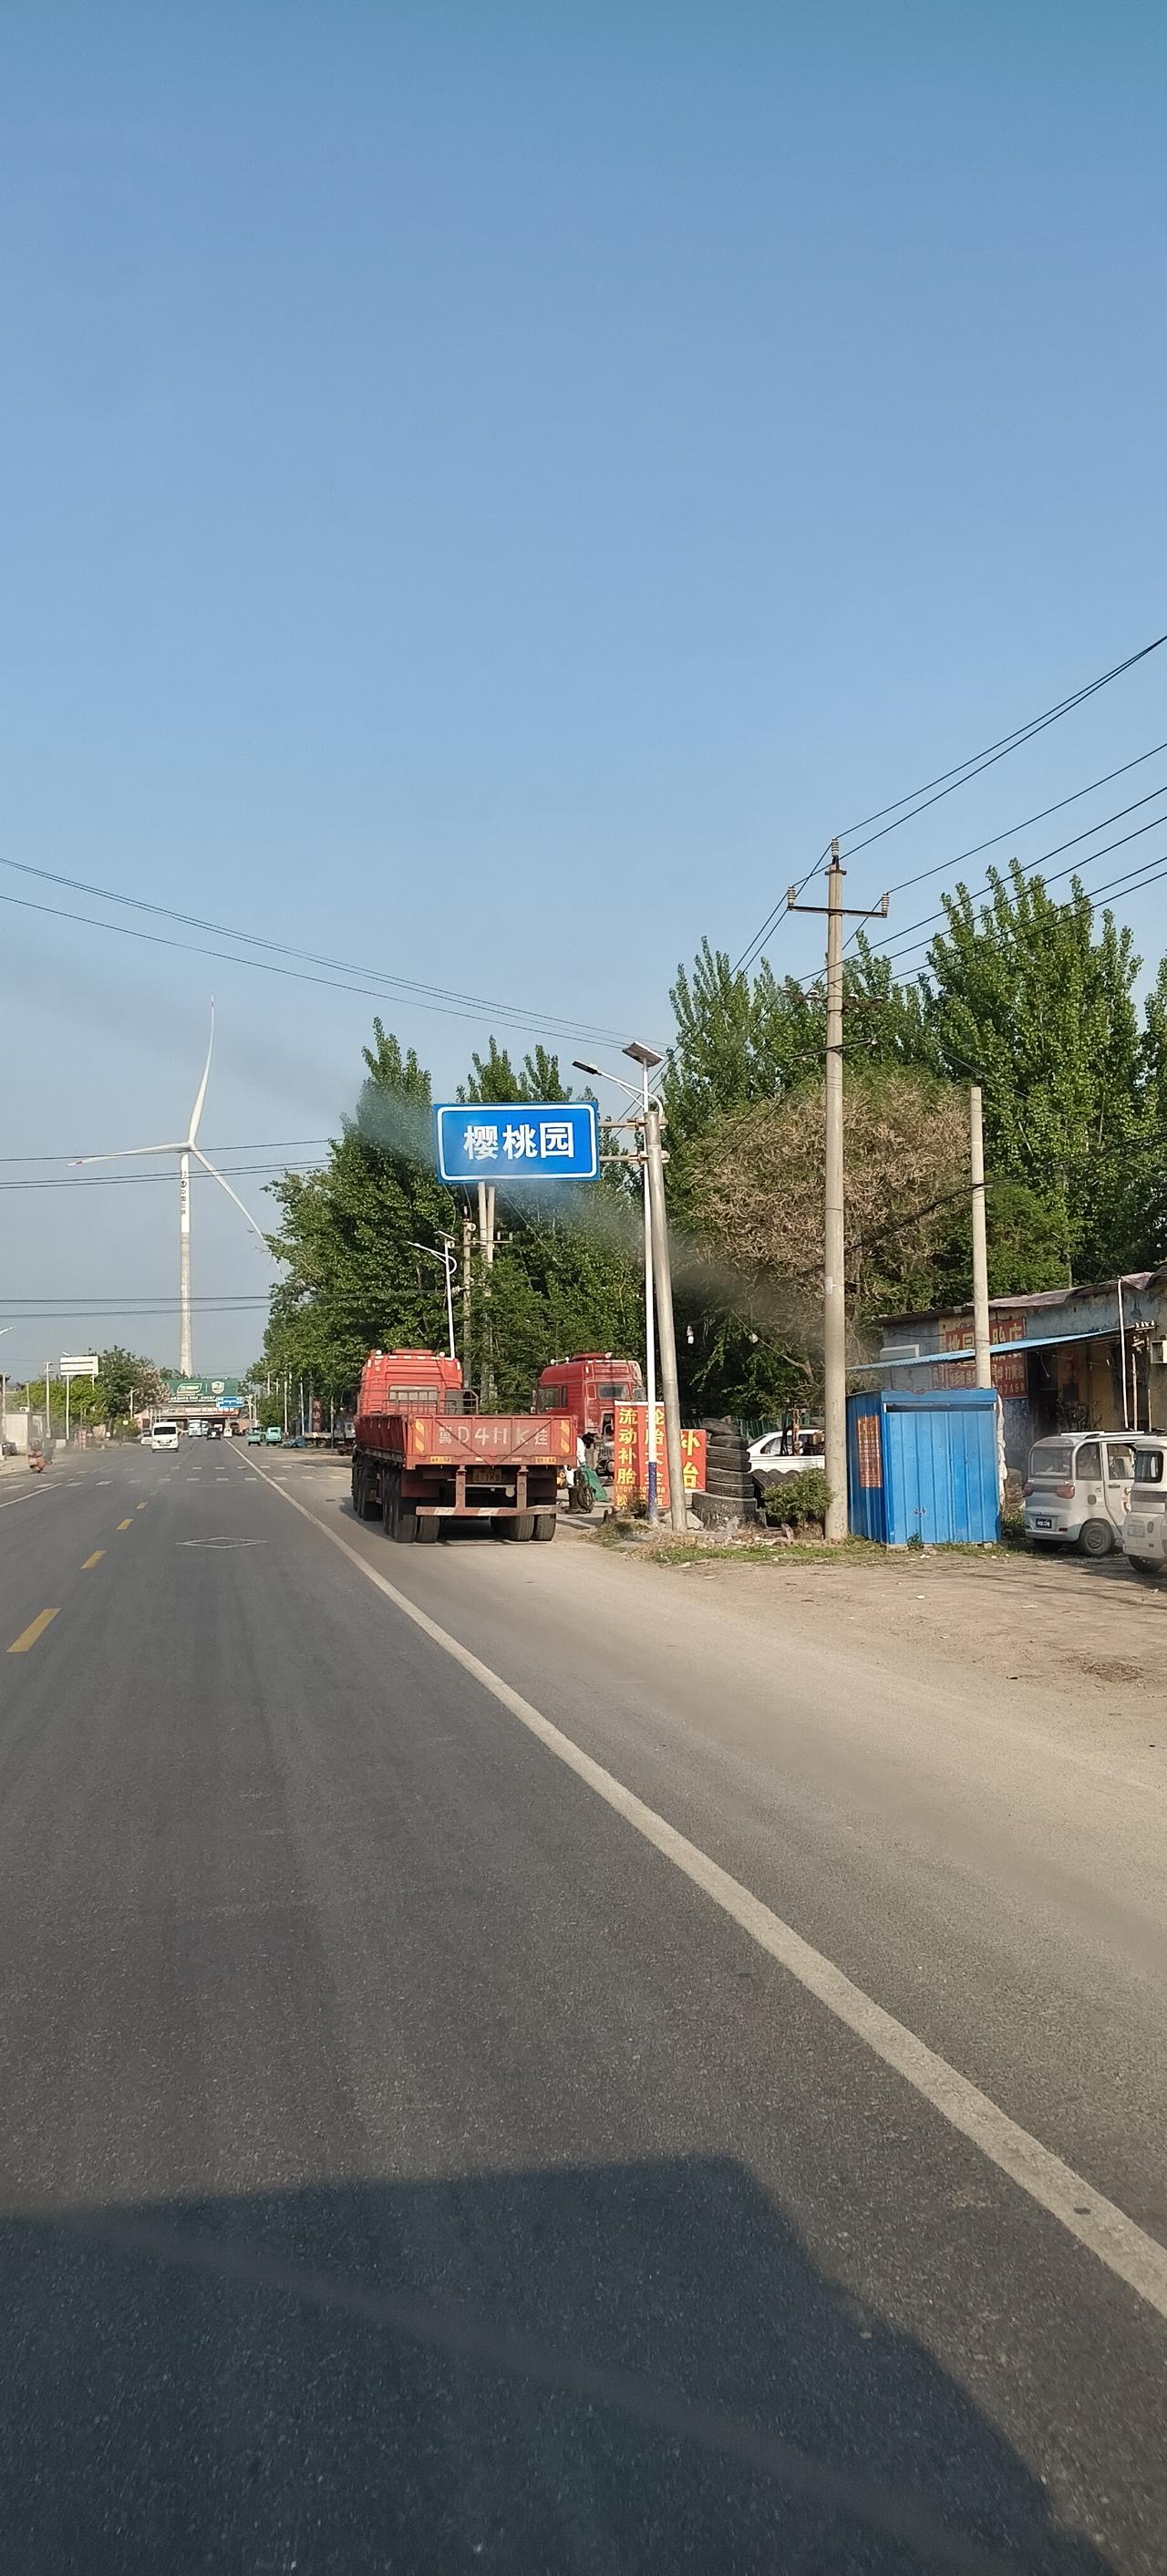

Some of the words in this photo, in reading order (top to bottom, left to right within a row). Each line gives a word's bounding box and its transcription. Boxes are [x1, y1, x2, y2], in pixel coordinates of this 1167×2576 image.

[463, 1122, 574, 1160] 樱桃园
[617, 1407, 638, 1485] 流动补胎
